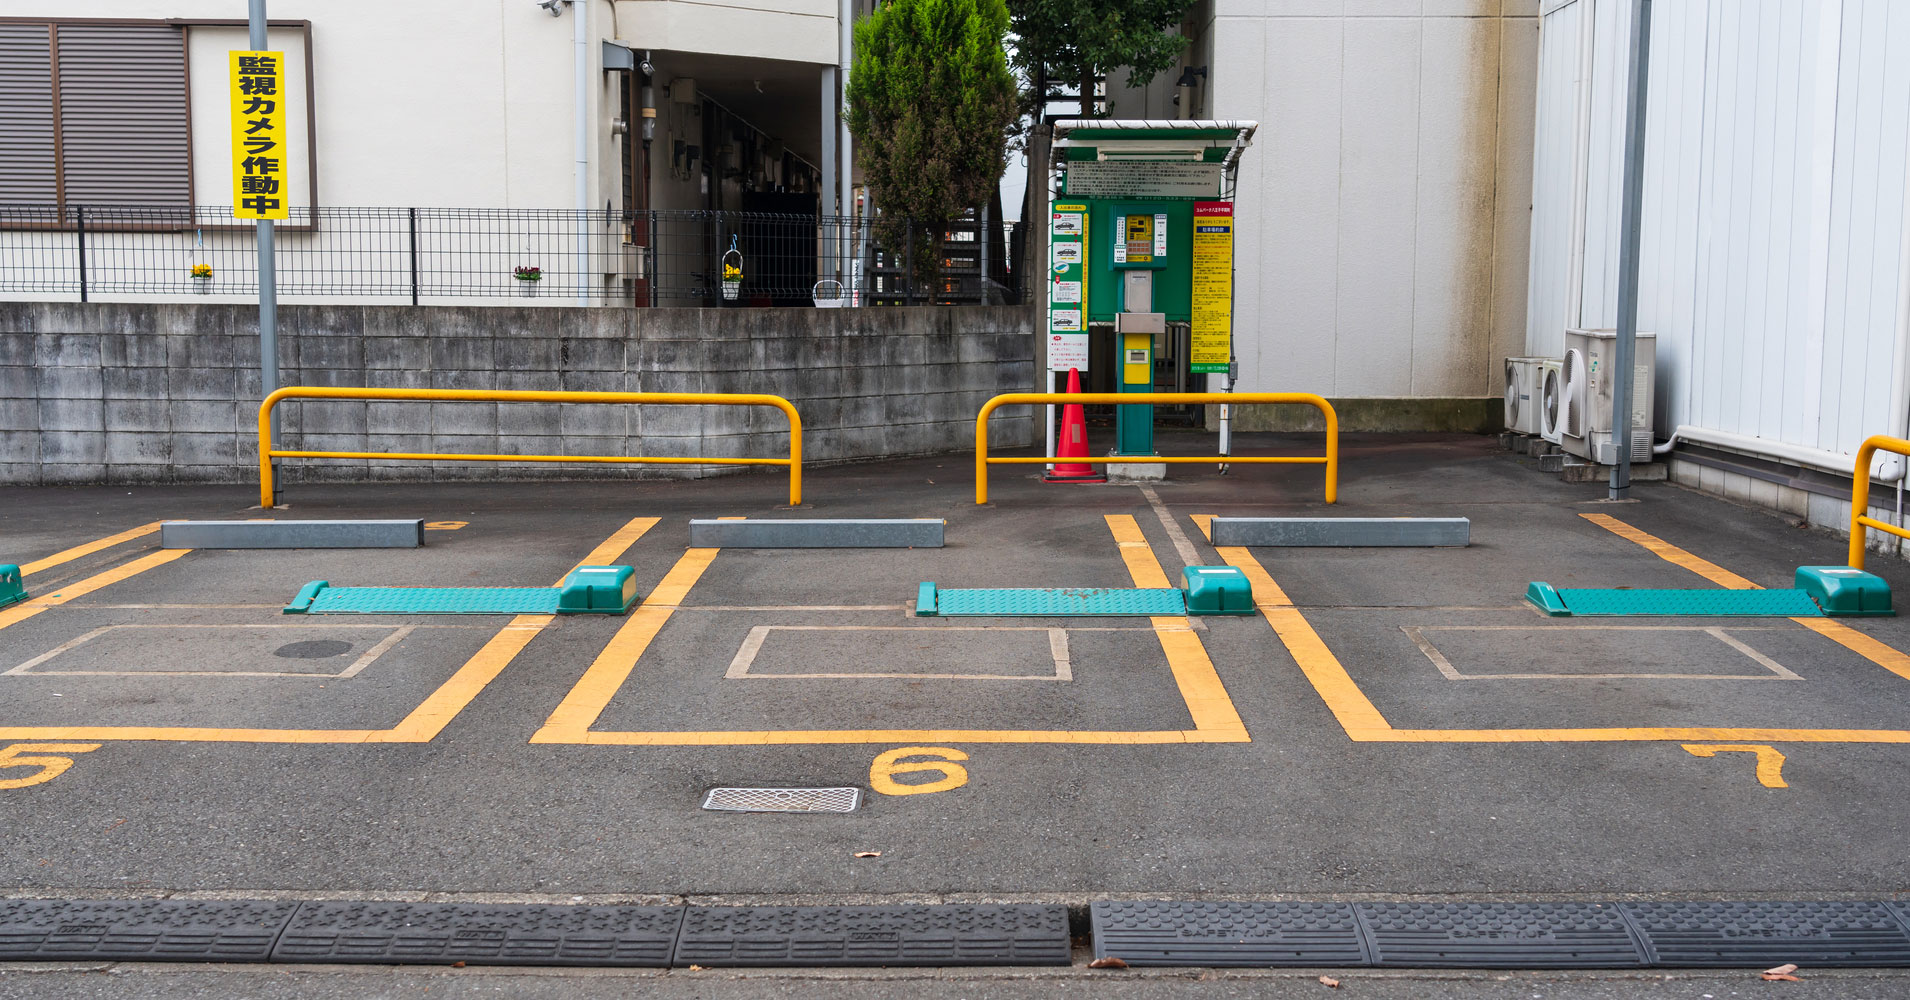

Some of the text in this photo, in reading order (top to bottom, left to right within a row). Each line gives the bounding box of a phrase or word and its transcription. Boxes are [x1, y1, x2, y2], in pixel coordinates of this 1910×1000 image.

[238, 56, 280, 215] 監視カメラ作動中
[0, 743, 103, 790] 5
[869, 746, 970, 797] 6
[1680, 744, 1789, 789] 7
